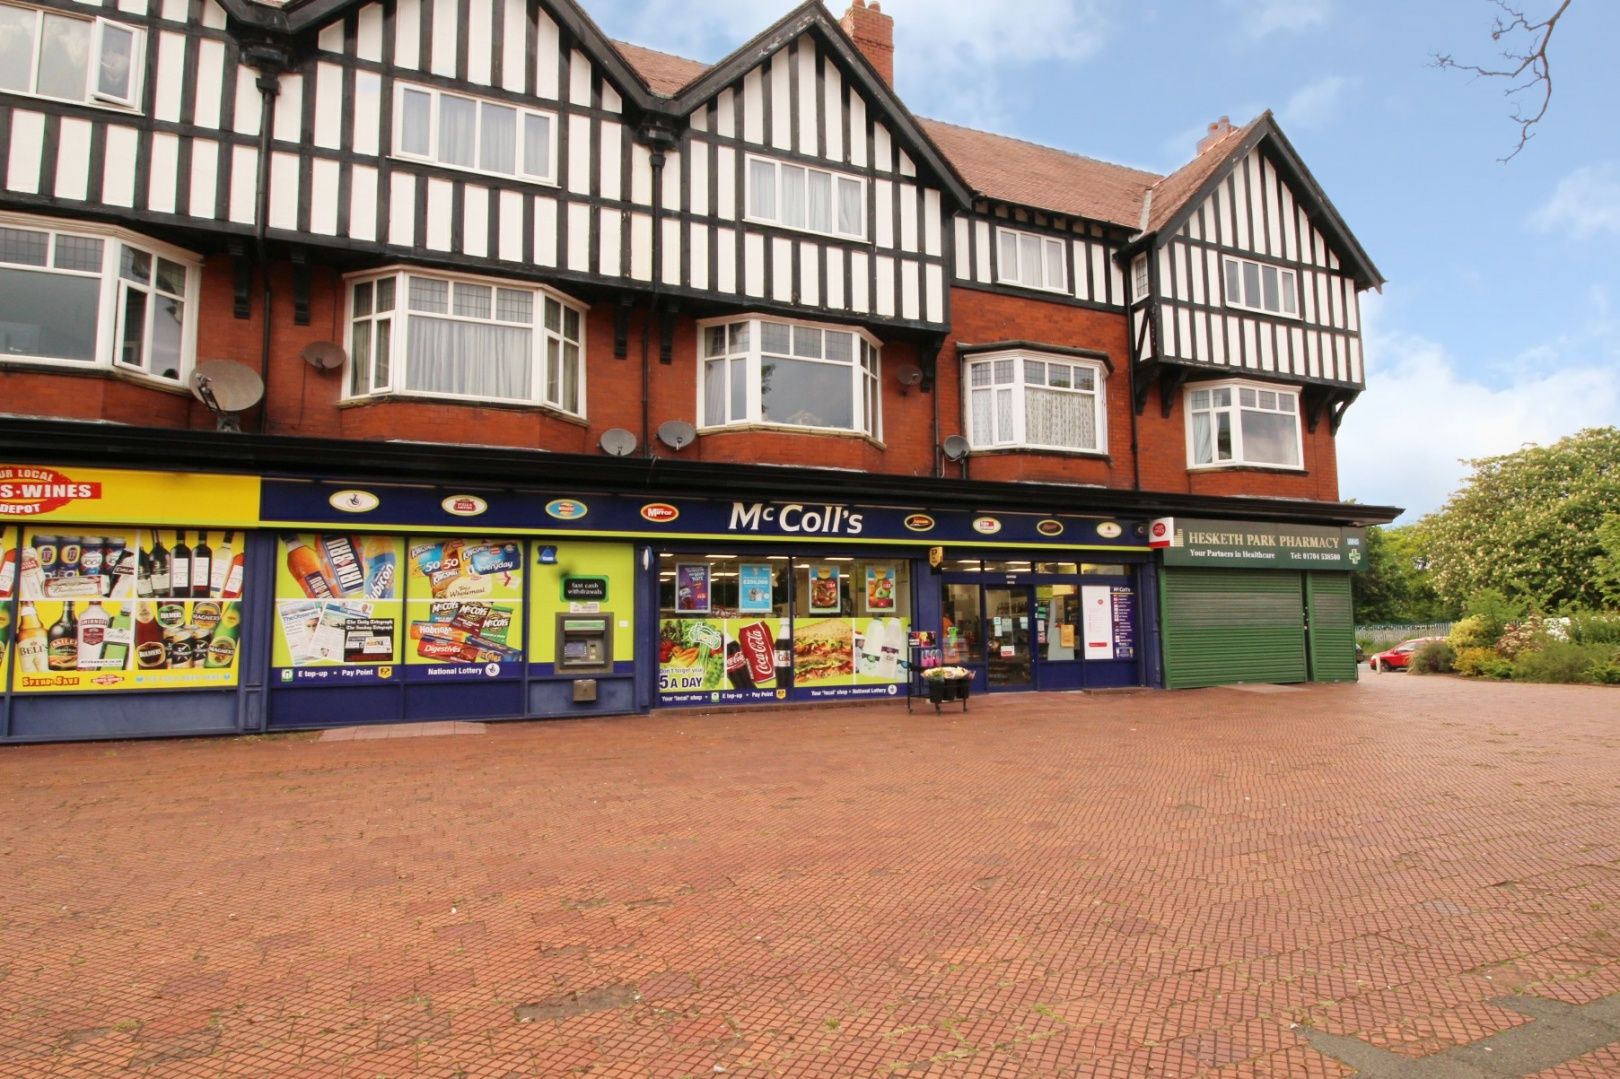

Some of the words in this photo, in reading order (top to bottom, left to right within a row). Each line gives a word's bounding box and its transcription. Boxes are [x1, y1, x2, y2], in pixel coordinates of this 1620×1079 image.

[18, 469, 53, 482] LOCAL
[0, 503, 40, 513] DEPOT
[1189, 532, 1244, 545] HESKETH
[1247, 535, 1276, 546] PARK
[1279, 536, 1340, 549] PHARMACY
[1190, 549, 1205, 557] Your
[1207, 549, 1234, 558] Partners
[1243, 550, 1276, 559] Healthcare
[425, 561, 440, 572] 50
[443, 558, 459, 570] 50
[341, 669, 355, 677] Pay
[428, 668, 457, 676] National
[459, 667, 482, 675] Lottery
[659, 675, 668, 689] 5
[670, 678, 678, 688] A
[682, 677, 702, 688] DAY
